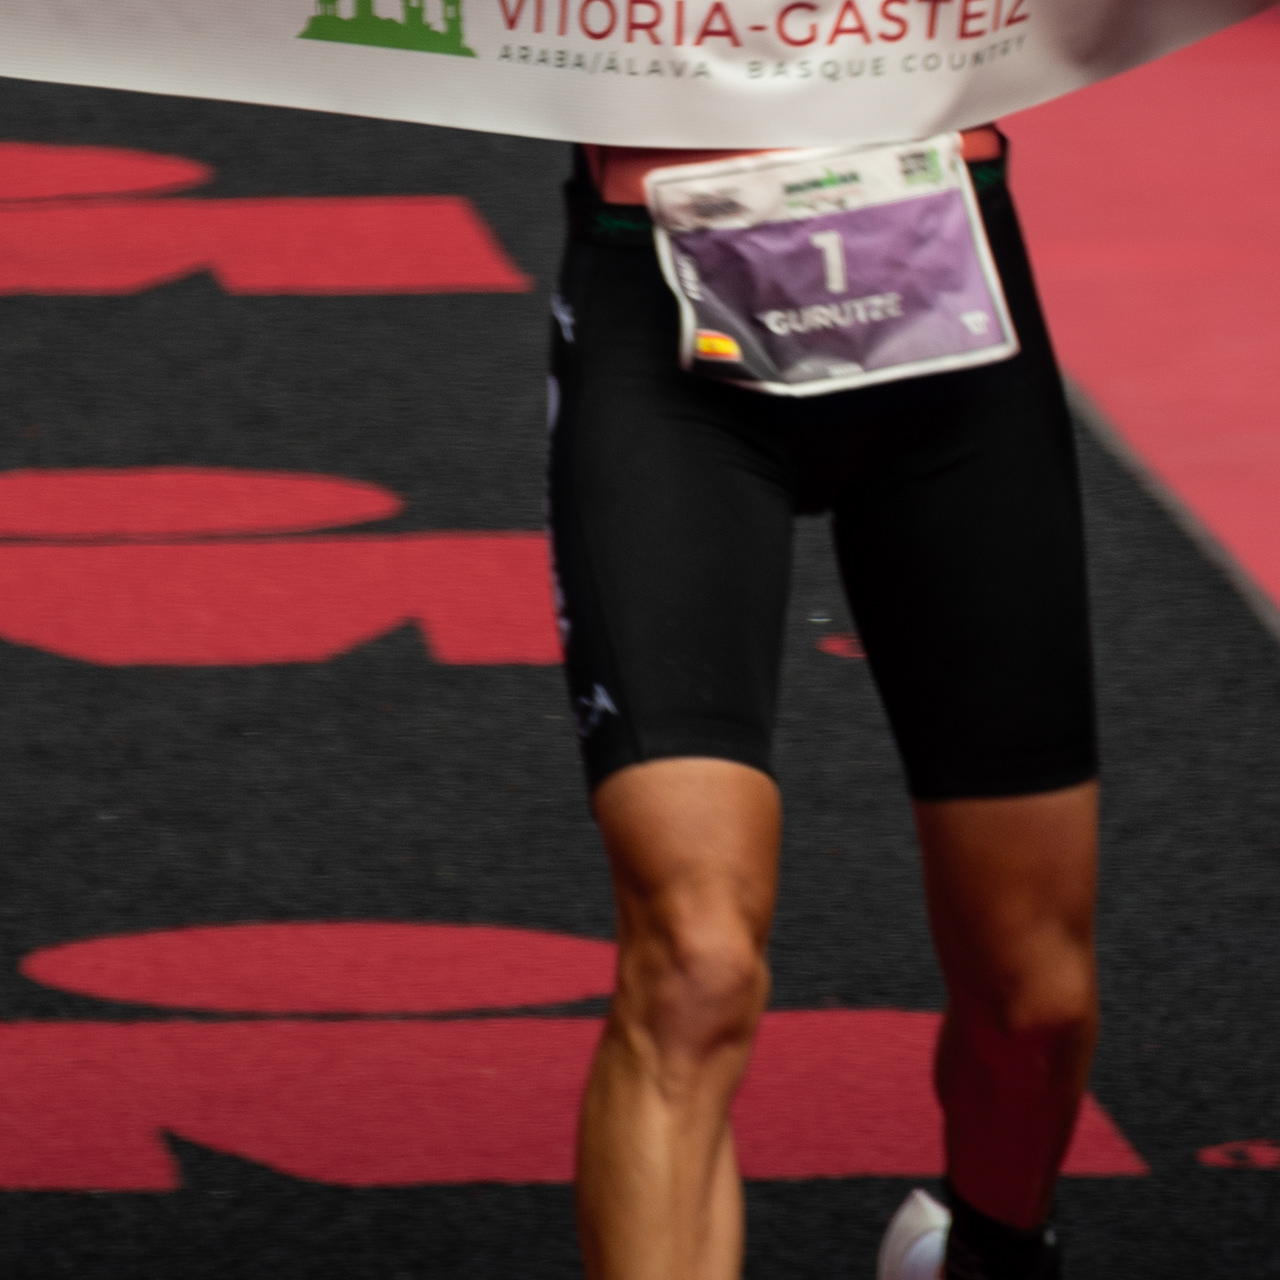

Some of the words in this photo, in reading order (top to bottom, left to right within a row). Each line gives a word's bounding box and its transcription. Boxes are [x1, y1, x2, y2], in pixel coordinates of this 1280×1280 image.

[747, 54, 888, 83] BASQUE
[902, 35, 1028, 76] COUNTRY
[809, 230, 848, 295] 1
